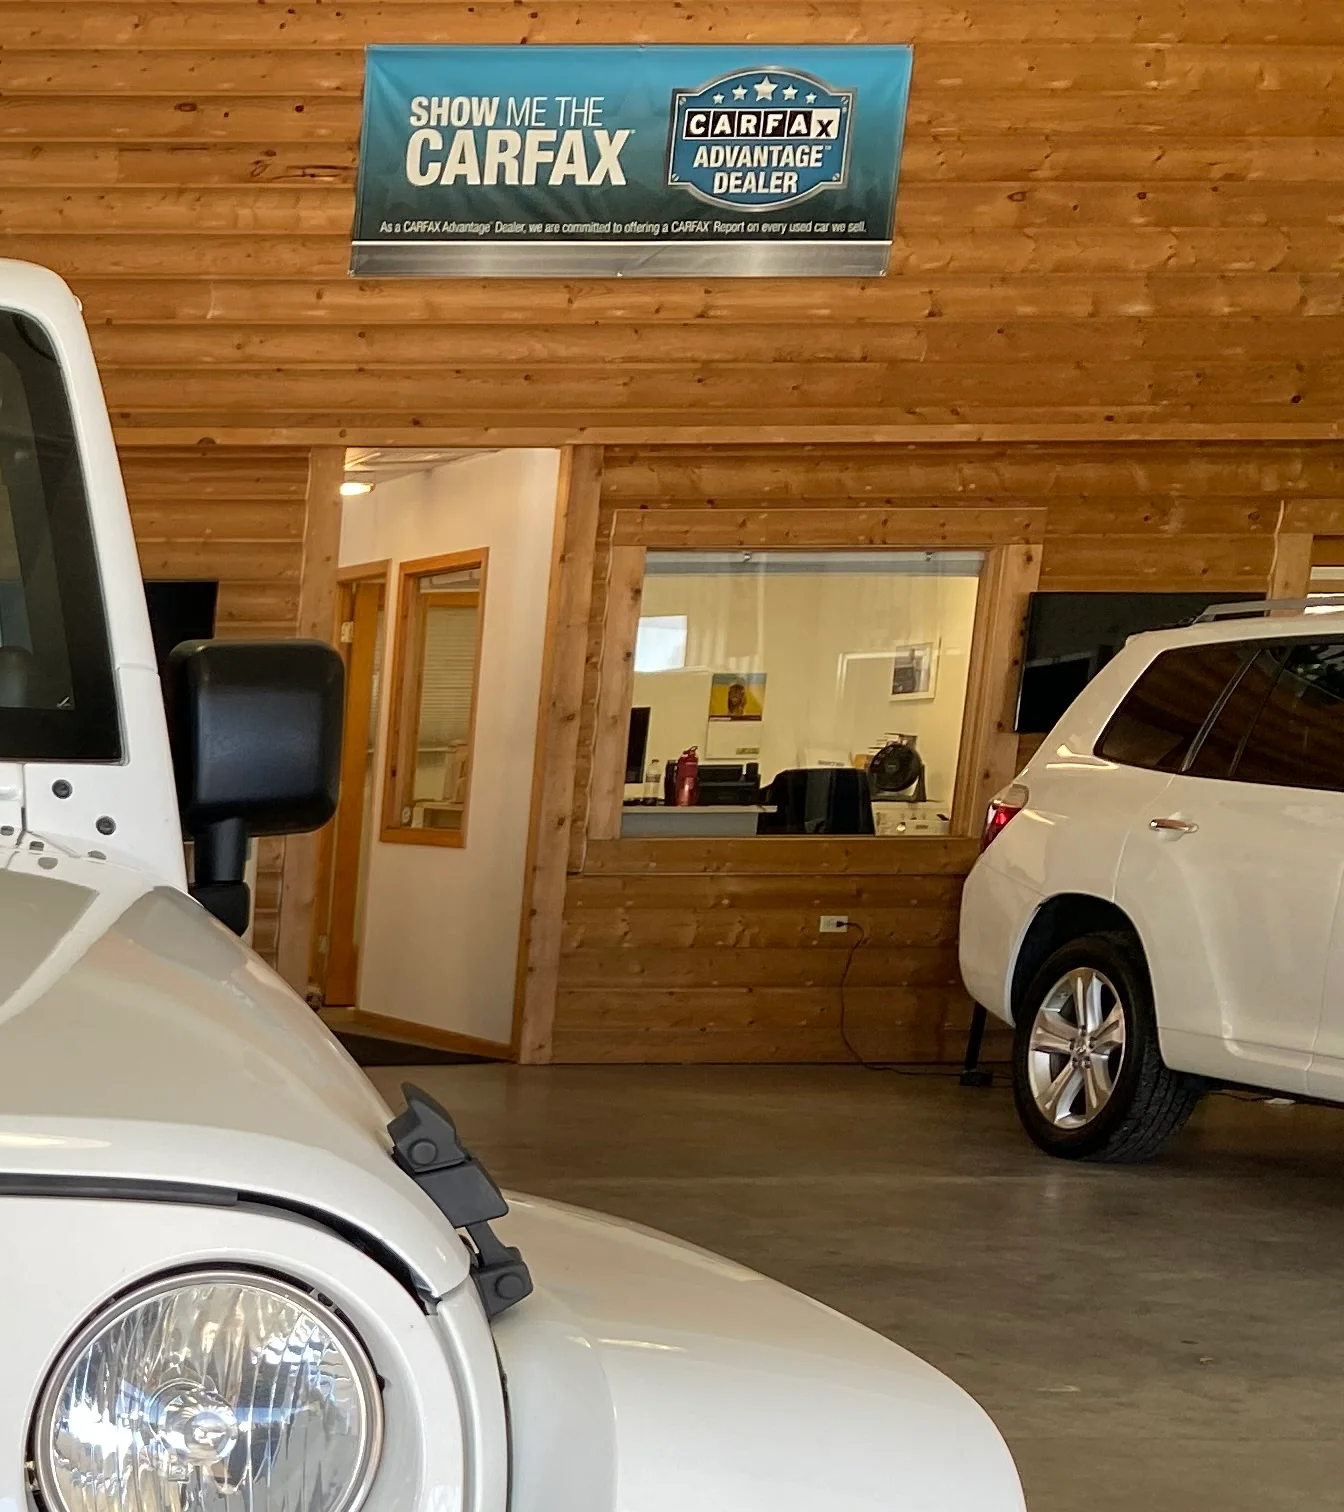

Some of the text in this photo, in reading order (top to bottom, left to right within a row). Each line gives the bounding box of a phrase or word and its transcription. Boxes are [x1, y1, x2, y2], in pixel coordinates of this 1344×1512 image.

[410, 96, 605, 127] SHOW ME THE
[685, 113, 833, 138] CARFAX
[406, 128, 631, 186] CARFAX
[693, 145, 824, 168] ADVANTAGE
[713, 171, 798, 194] DEALER
[380, 221, 392, 232] As
[403, 221, 440, 233] CARFAX
[495, 221, 526, 234] Dealer,
[529, 224, 543, 232] we
[545, 224, 560, 232] are
[562, 221, 611, 233] committed
[613, 222, 622, 232] to
[624, 221, 660, 235] offering
[671, 221, 708, 232] CARFAX
[713, 221, 745, 234] Report
[747, 224, 759, 232] on
[762, 224, 787, 235] every
[790, 221, 812, 232] used
[814, 224, 830, 232] car
[832, 224, 845, 232] we
[847, 221, 866, 232] sell.
